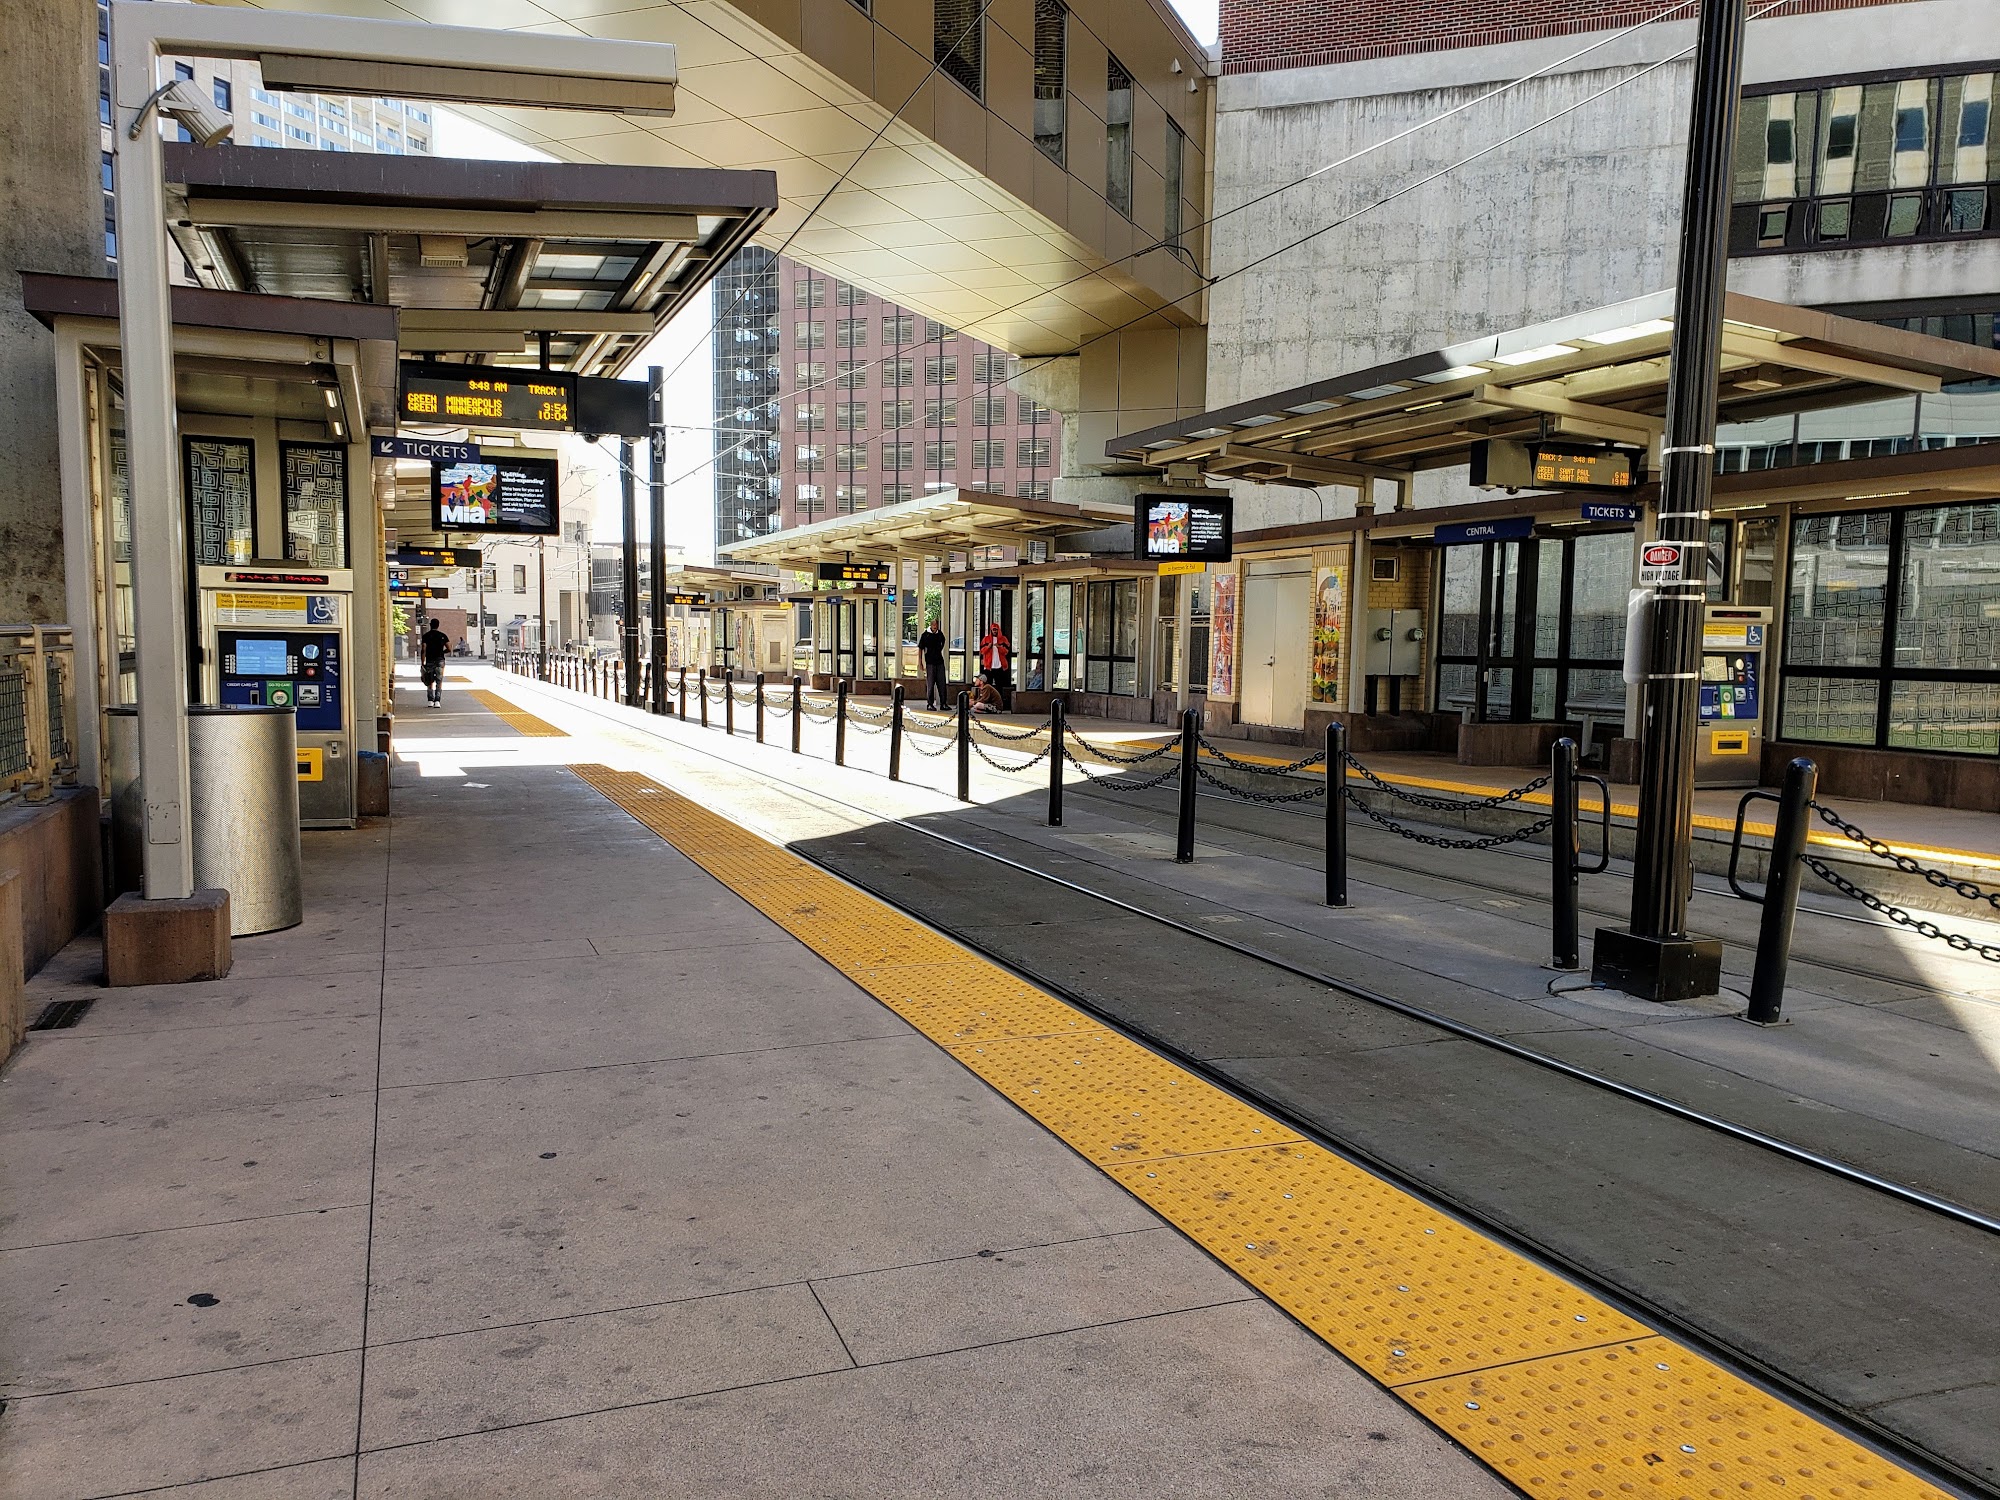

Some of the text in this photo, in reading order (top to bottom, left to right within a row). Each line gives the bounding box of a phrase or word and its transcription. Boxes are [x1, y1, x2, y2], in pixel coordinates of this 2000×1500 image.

[468, 380, 508, 393] 9:48 AM
[528, 384, 565, 396] TRACK 1
[407, 393, 568, 412] GREEN MINNEAPOLIS 9:54
[407, 402, 568, 421] GREEN MINNEAPOLIS 10:04
[403, 442, 468, 459] TICKETS
[1538, 453, 1563, 462] TRACK 2
[1537, 466, 1555, 474] GREEN
[1577, 469, 1590, 477] PAUL
[1537, 472, 1555, 480] GREEN
[441, 505, 486, 523] Mia
[1589, 506, 1625, 518] TICKETS
[1466, 525, 1496, 537] CENTRAL
[1148, 538, 1180, 554] Mia
[1649, 550, 1673, 562] DANGER
[1641, 570, 1654, 581] HIGH
